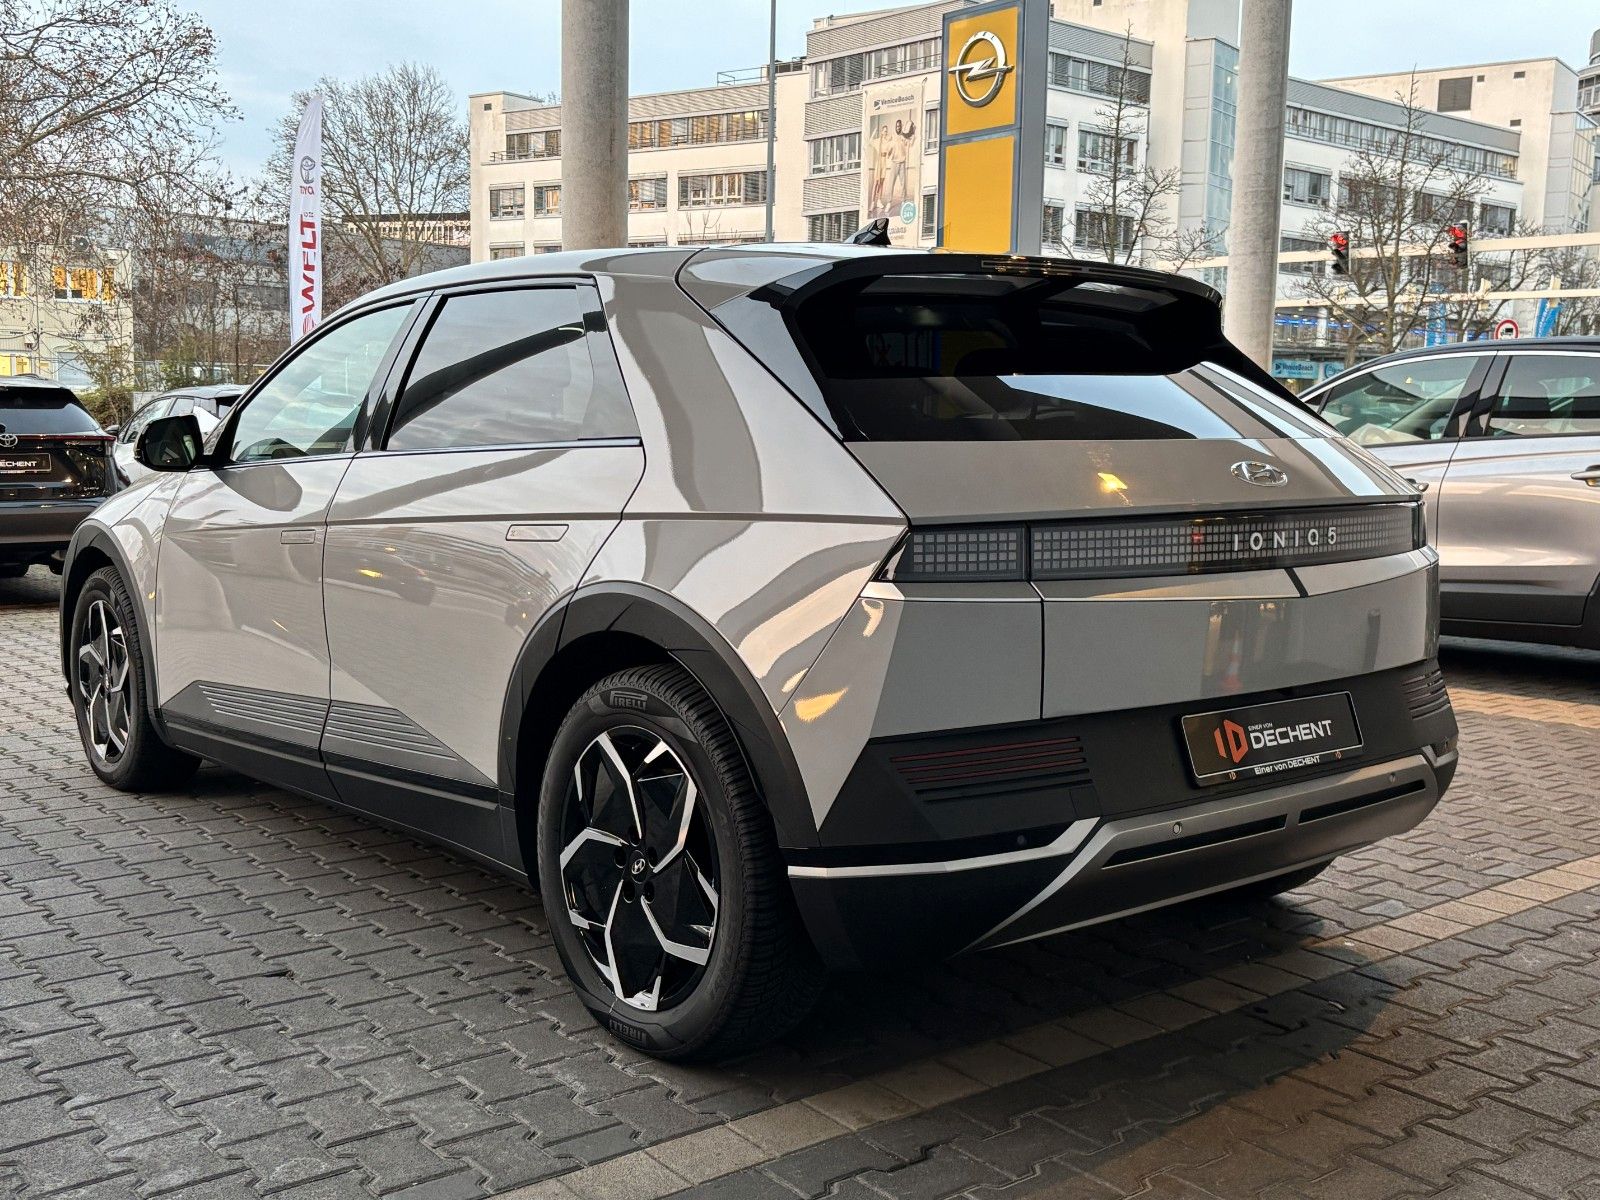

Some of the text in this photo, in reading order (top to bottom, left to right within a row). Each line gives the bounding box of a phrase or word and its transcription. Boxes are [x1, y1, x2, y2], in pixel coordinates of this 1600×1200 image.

[0, 460, 37, 468] ECHENT
[1233, 526, 1337, 552] IONIQ 5
[609, 690, 648, 711] PIRELLI
[1247, 724, 1263, 732] EINER
[1249, 719, 1332, 749] DECHENT
[1254, 755, 1320, 775] Einer von DECHENT
